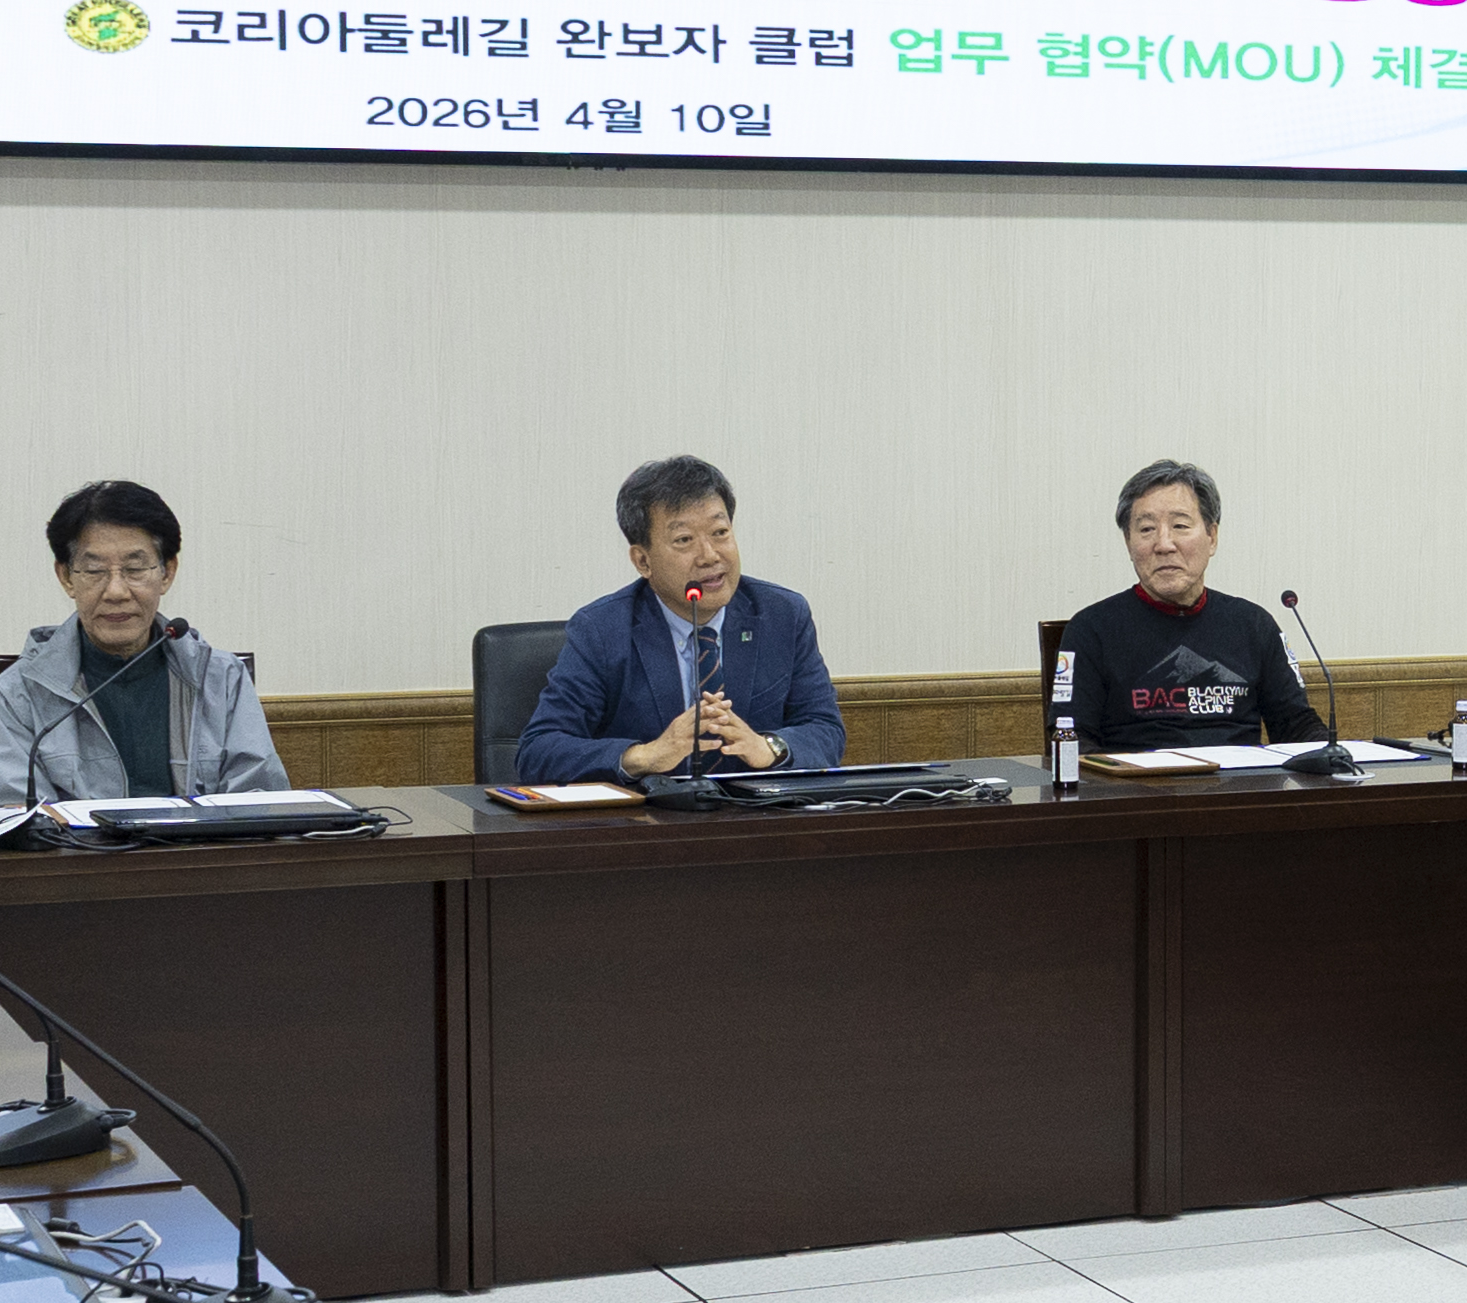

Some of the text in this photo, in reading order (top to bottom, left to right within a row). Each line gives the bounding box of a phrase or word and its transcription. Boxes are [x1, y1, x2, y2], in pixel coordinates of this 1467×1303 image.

[170, 8, 530, 59] 코리아둘레길
[555, 18, 728, 65] 완보자
[748, 25, 854, 74] 클럽
[888, 27, 1012, 76] 업무
[1036, 33, 1345, 89] 협약(MOU)
[365, 95, 772, 138] 2026년 4월 10일
[1131, 687, 1187, 709] BAC
[1188, 695, 1235, 706] ALPINE
[1189, 704, 1224, 714] CLUB
